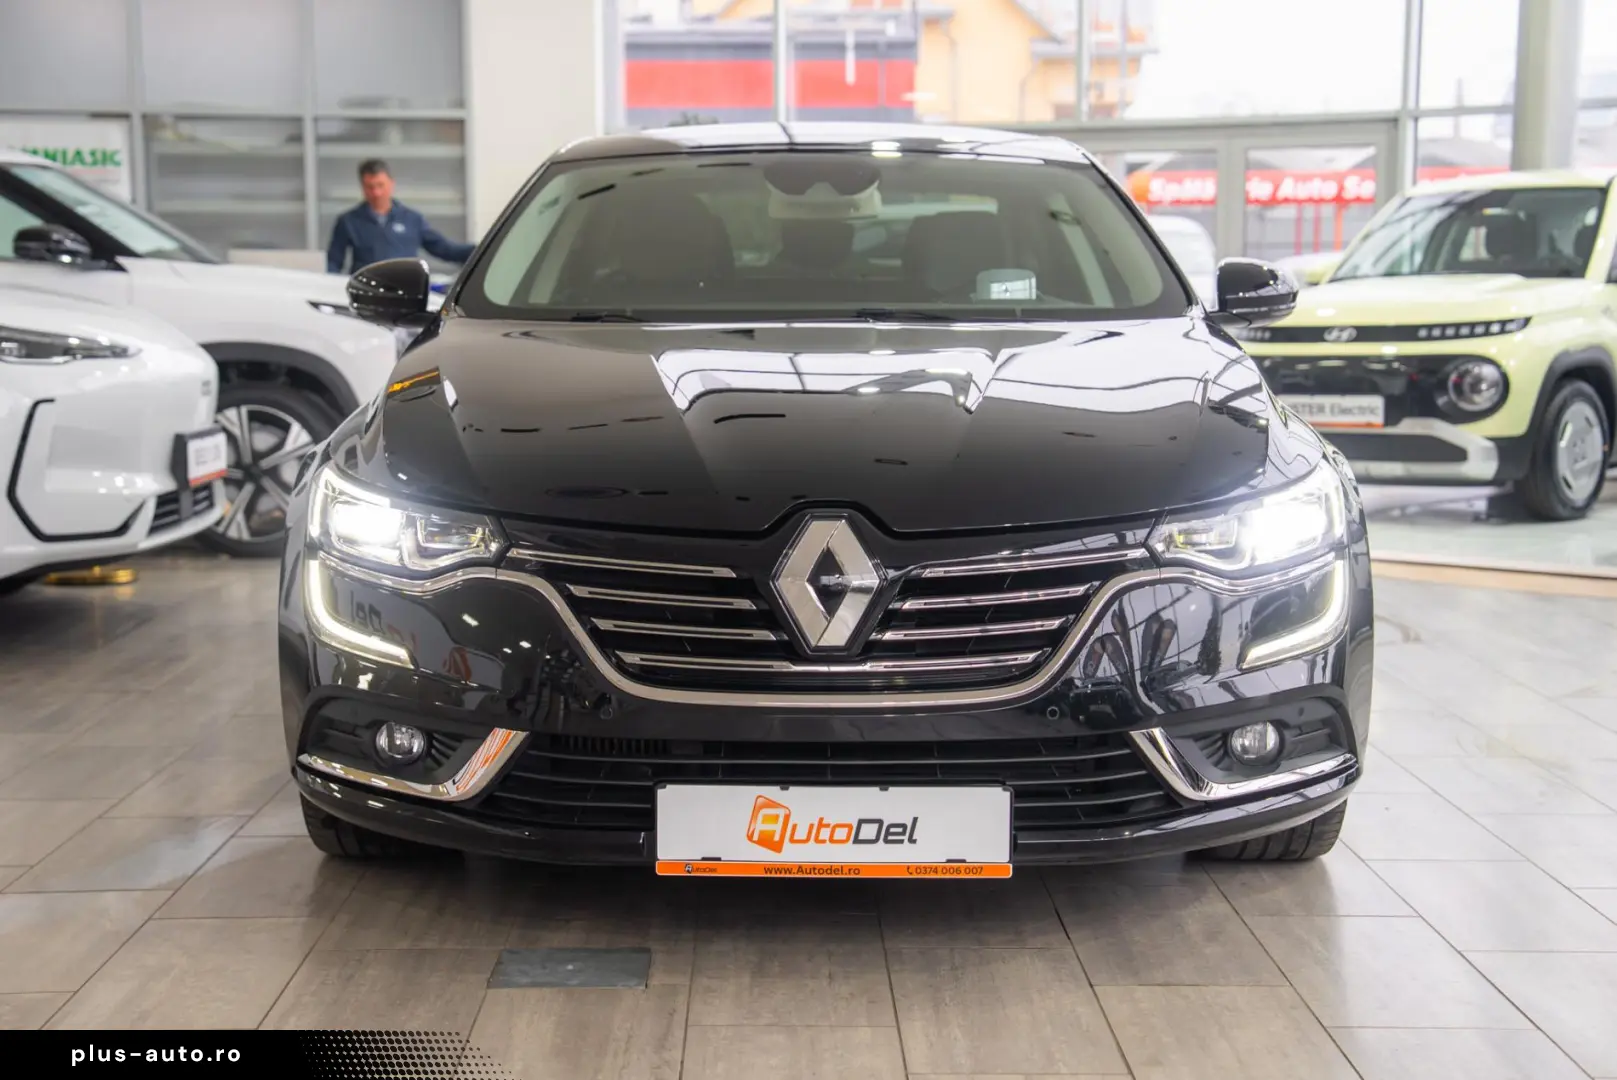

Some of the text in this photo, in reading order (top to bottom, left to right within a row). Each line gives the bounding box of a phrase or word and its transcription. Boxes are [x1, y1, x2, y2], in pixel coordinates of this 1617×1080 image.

[1276, 176, 1340, 200] Auto
[748, 799, 919, 850] AutoDel
[763, 865, 861, 876] www.Autodel.ro
[915, 866, 983, 875] 0374 006 007
